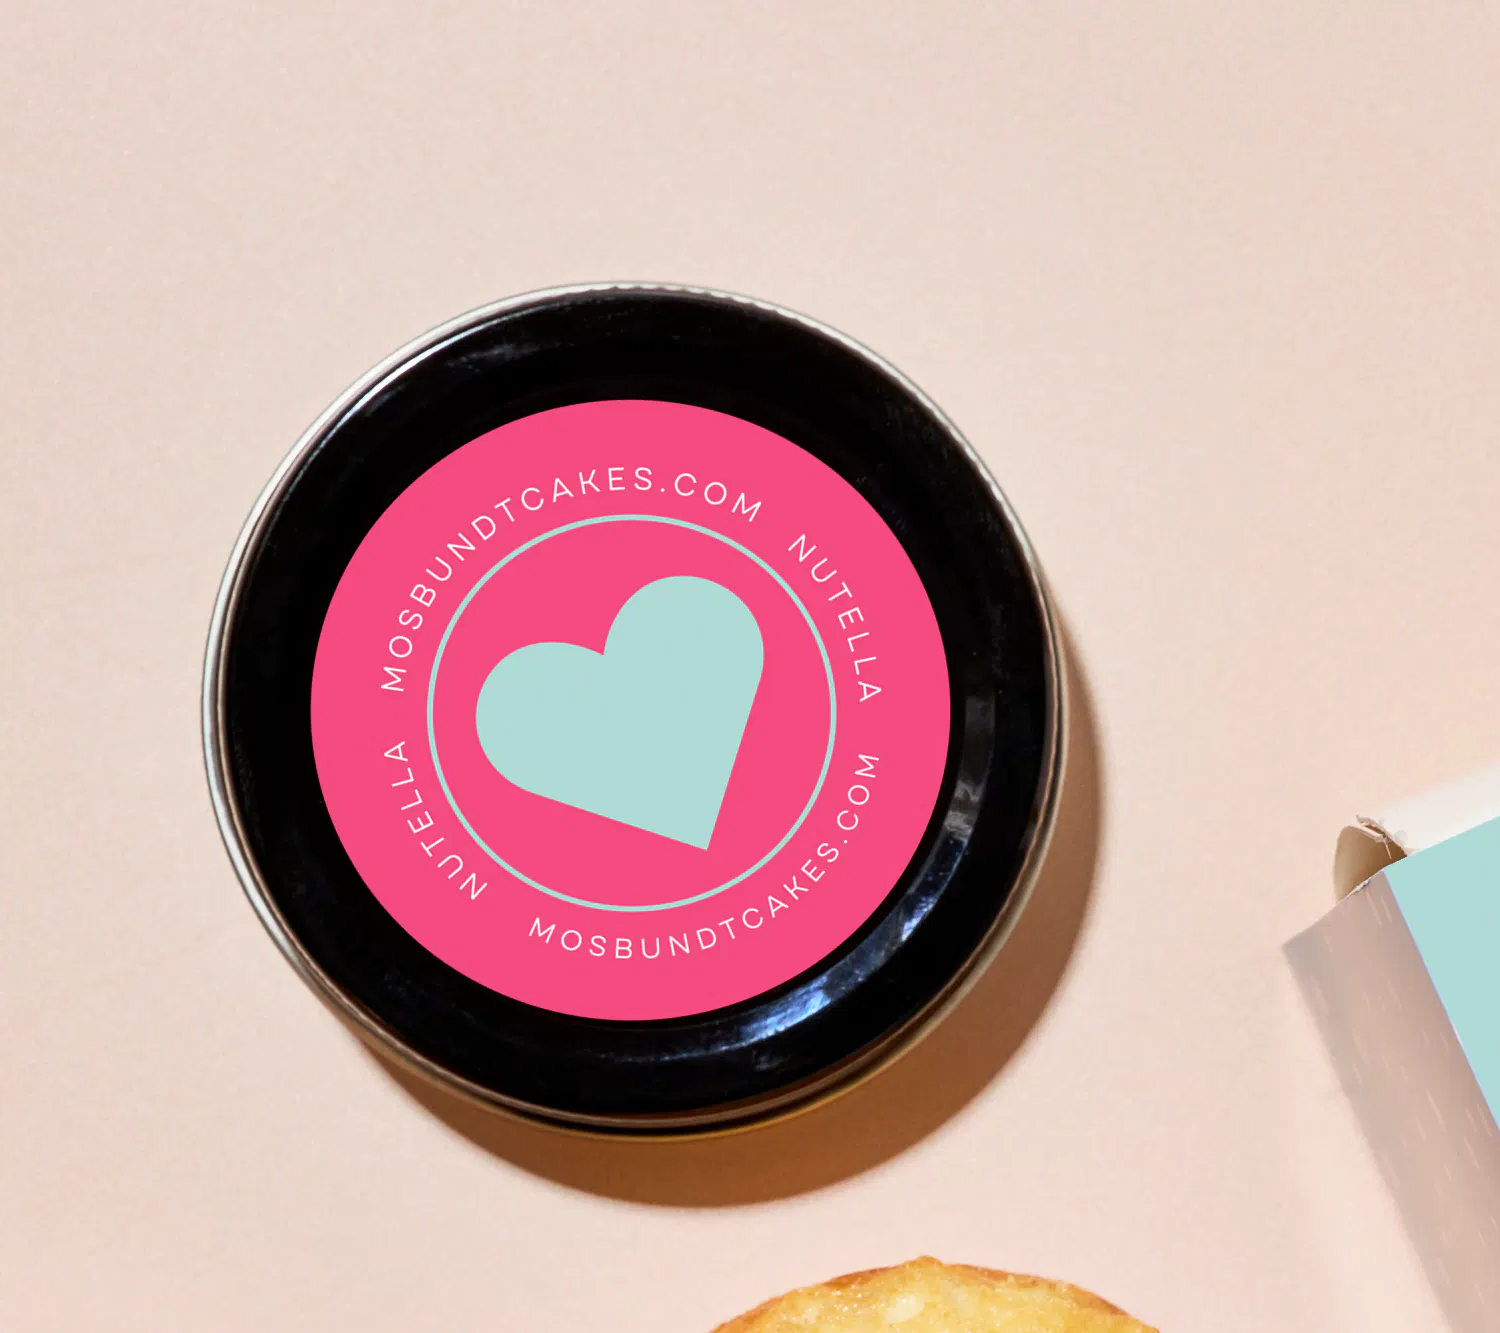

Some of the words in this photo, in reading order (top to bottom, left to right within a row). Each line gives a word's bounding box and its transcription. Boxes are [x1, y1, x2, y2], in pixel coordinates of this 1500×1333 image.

[381, 467, 761, 691] MOSBUNDTCAKES.COM
[788, 534, 881, 702] NUTELLA
[384, 741, 487, 900] NUTELLA
[529, 755, 879, 958] MOSBUNDTCAKES.COM
